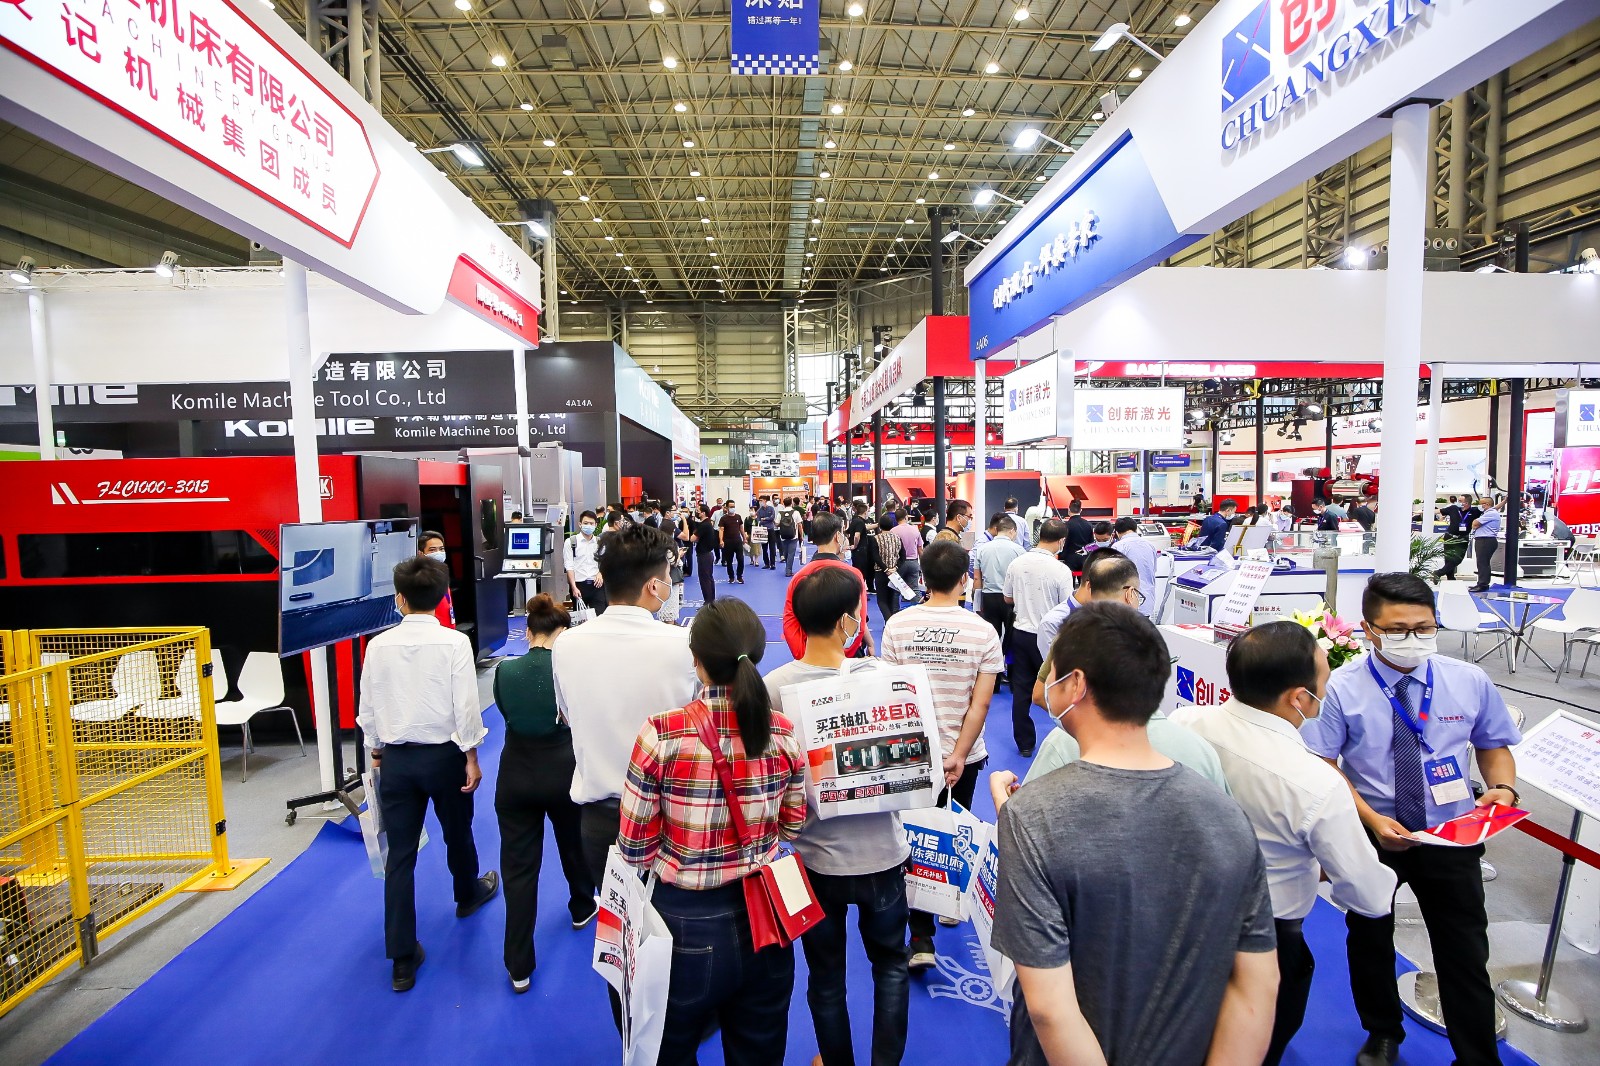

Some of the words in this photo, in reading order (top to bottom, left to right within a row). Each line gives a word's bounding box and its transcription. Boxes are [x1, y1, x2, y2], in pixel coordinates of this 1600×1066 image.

[747, 15, 802, 26] 错过再等一年!
[83, 0, 257, 127] ACHINERY
[128, 0, 334, 157] 机床有限公司
[312, 358, 447, 382] 造有限公司
[171, 392, 237, 410] Komile
[243, 389, 325, 409] Mache
[329, 390, 370, 407] Tool
[375, 389, 412, 407] Co.,
[417, 388, 446, 406] Ltd
[565, 399, 593, 407] 4A14A
[1018, 380, 1051, 407] 创新激光
[1107, 406, 1171, 421] 创新激光
[394, 426, 436, 439] Komile
[439, 425, 490, 437] Machine
[548, 423, 566, 435] Ltd
[915, 645, 945, 653] TEMPERATURE
[815, 711, 869, 735] 买五轴机
[871, 702, 920, 723] 找巨风
[916, 867, 943, 880] 亿元补贴
